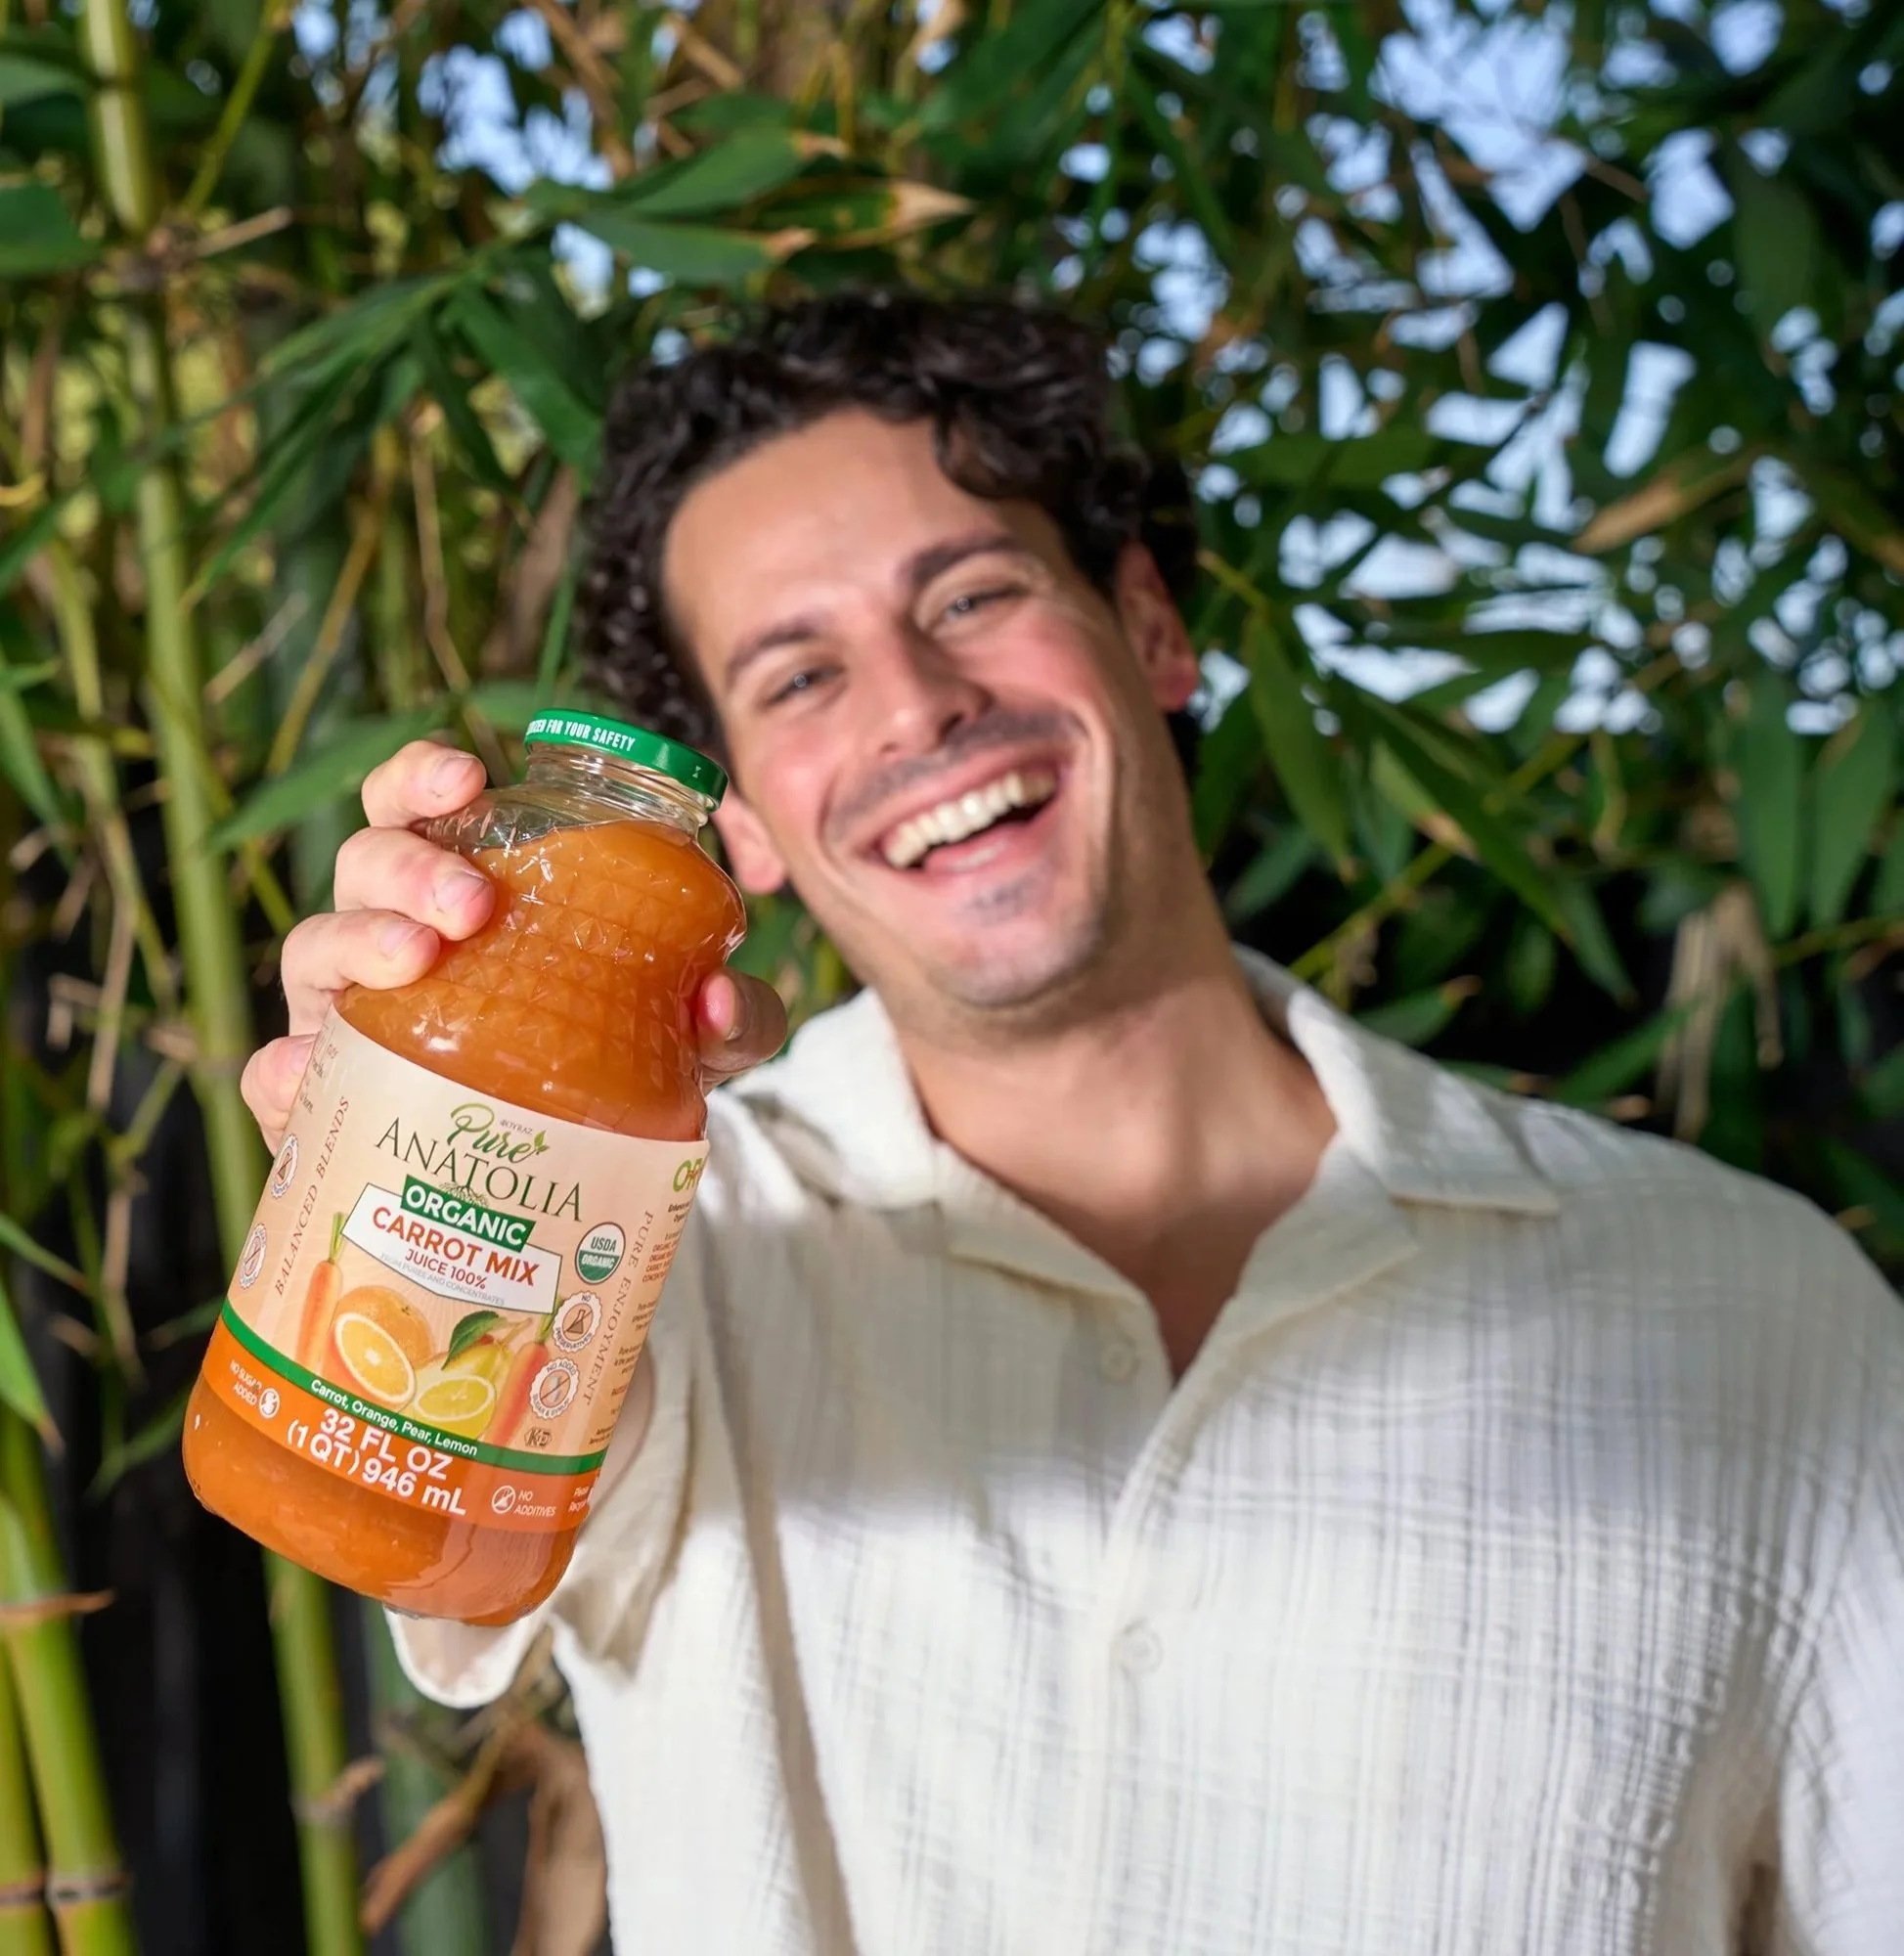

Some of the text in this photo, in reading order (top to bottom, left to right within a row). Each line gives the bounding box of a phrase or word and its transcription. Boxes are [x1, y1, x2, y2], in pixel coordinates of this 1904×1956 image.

[546, 719, 564, 734] FOR
[564, 721, 592, 739] YOUR
[592, 727, 636, 751] SAFETY
[447, 1102, 537, 1164] Pure
[276, 1183, 318, 1296] BALANCED
[315, 1095, 350, 1179] BLENDS
[376, 1117, 582, 1222] ANATOLIA
[405, 1184, 526, 1245] ORGANIC
[628, 1211, 653, 1267] PURE
[373, 1206, 540, 1286] CARROT MIX
[405, 1248, 487, 1289] JUICE 100%
[581, 1254, 615, 1268] ORGANIC
[591, 1236, 616, 1252] USDA
[426, 1272, 445, 1285] AND
[583, 1277, 632, 1405] ENJOYMENT
[234, 1381, 257, 1406] ADDED
[311, 1379, 478, 1457] Carrot, Orange, Pear, Lemon
[321, 1407, 453, 1481] 32 FL OZ
[362, 1457, 418, 1497] 946
[421, 1484, 466, 1516] mL
[513, 1504, 555, 1517] ADDITIVES
[518, 1489, 533, 1501] NO
